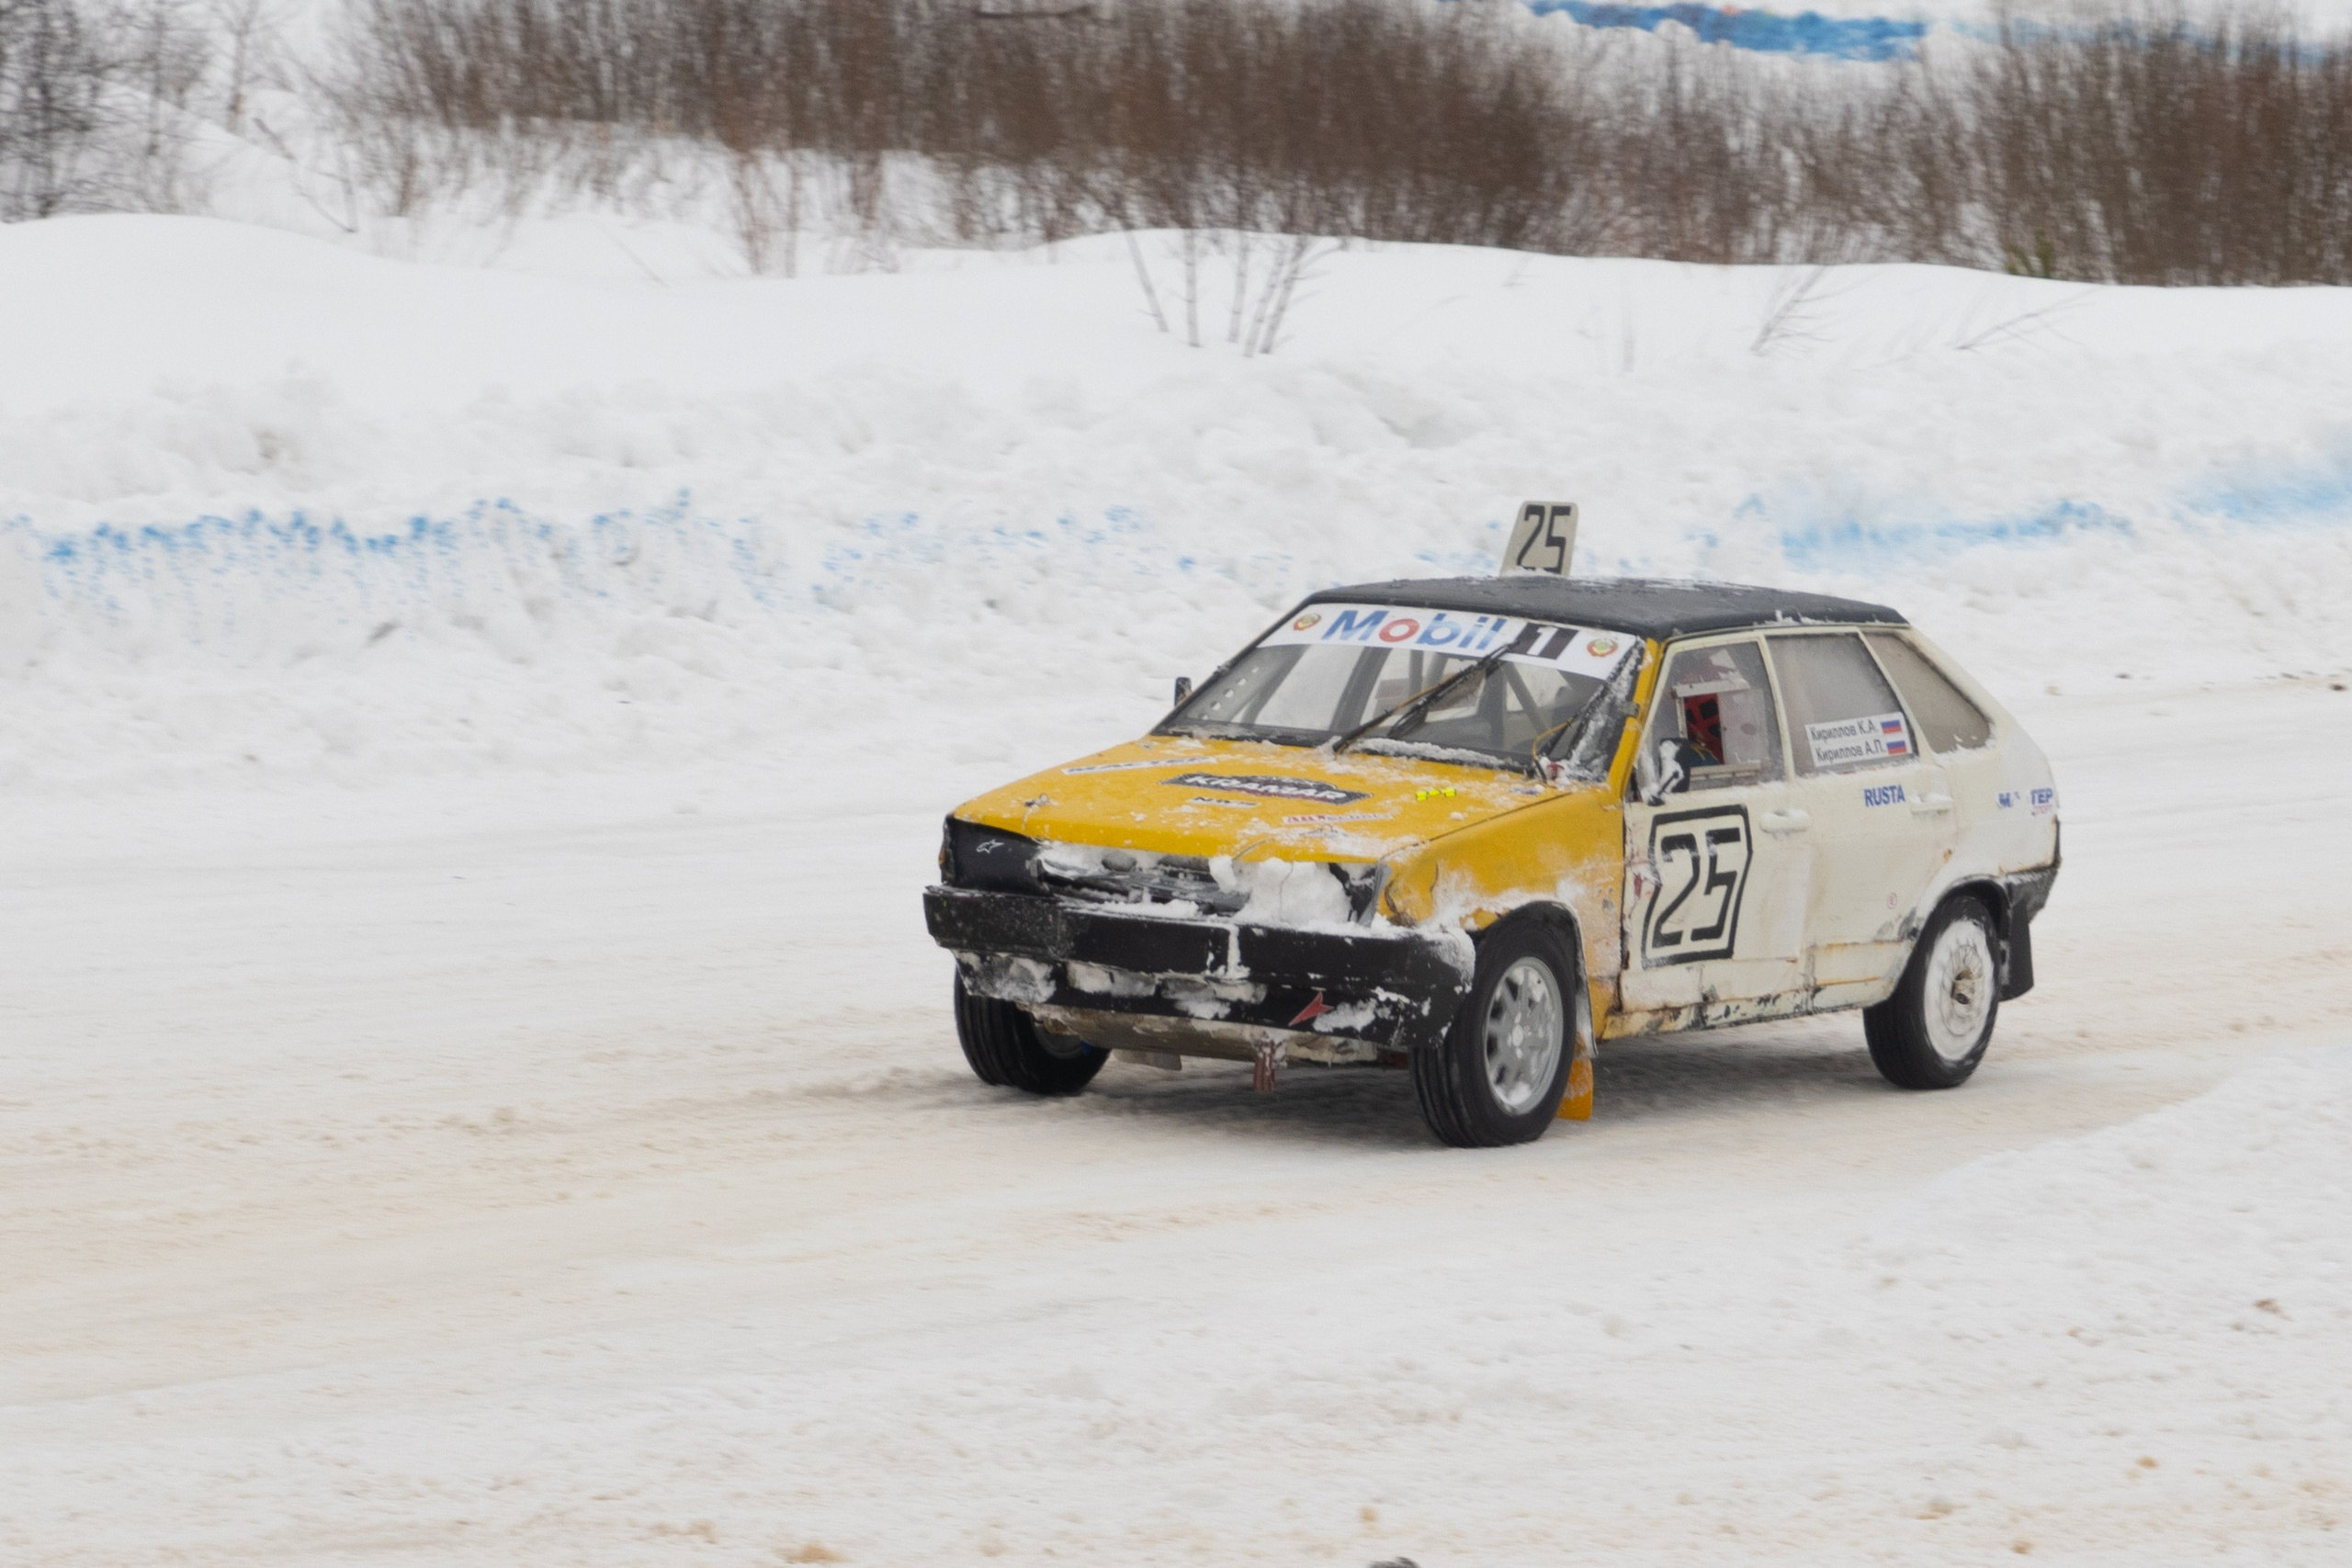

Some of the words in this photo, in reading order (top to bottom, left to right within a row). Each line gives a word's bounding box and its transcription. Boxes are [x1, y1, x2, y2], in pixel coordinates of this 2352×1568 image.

[1516, 504, 1571, 574] 25
[1321, 610, 1508, 650] Mobil
[1525, 626, 1554, 657] 1
[1809, 725, 1858, 743] Кириллов
[1815, 745, 1864, 763] Кириллов
[1863, 784, 1906, 807] RUSTA
[1652, 827, 1741, 948] 25
